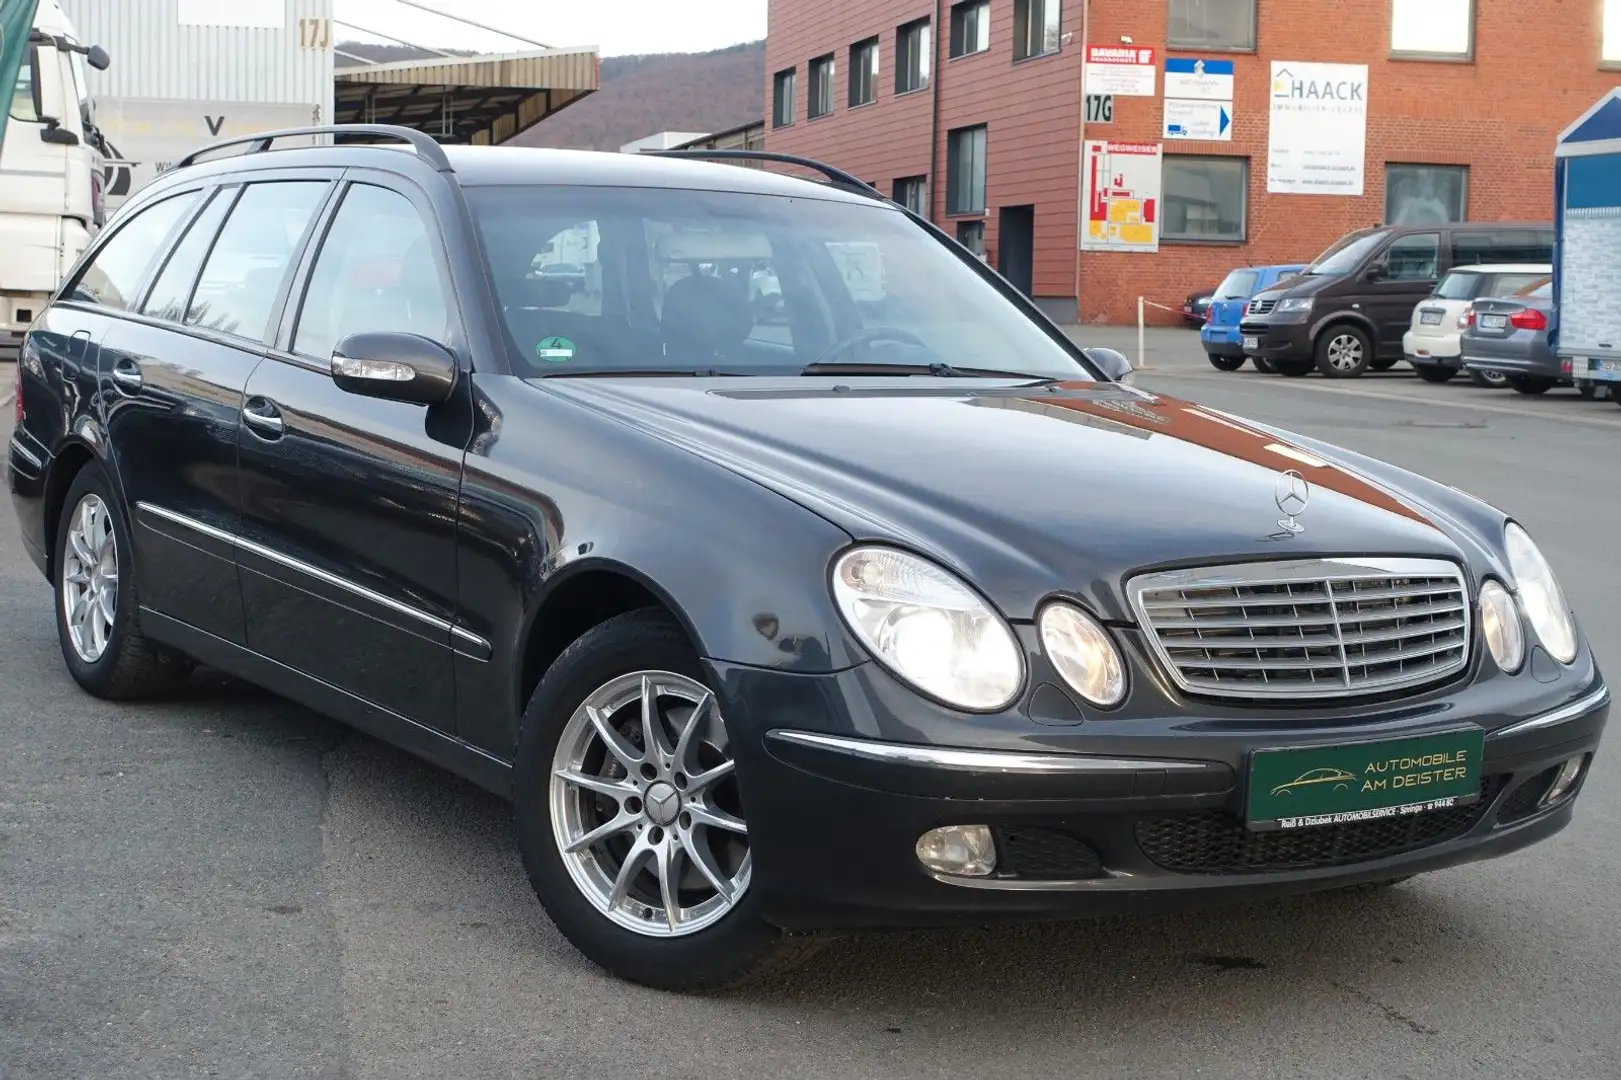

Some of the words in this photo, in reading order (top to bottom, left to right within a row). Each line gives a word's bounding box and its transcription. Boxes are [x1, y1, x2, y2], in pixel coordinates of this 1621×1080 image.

[299, 18, 329, 48] 17J
[1090, 47, 1137, 57] BAVARIA
[1291, 79, 1363, 101] HAACK
[1086, 95, 1112, 122] 17G
[550, 337, 562, 349] 4
[1364, 749, 1468, 774] AUTOMOBILE
[1360, 779, 1387, 793] AM
[1392, 766, 1467, 789] DEISTER
[1297, 818, 1304, 827] &
[1333, 807, 1396, 823] AUTOMOBILSERVICE
